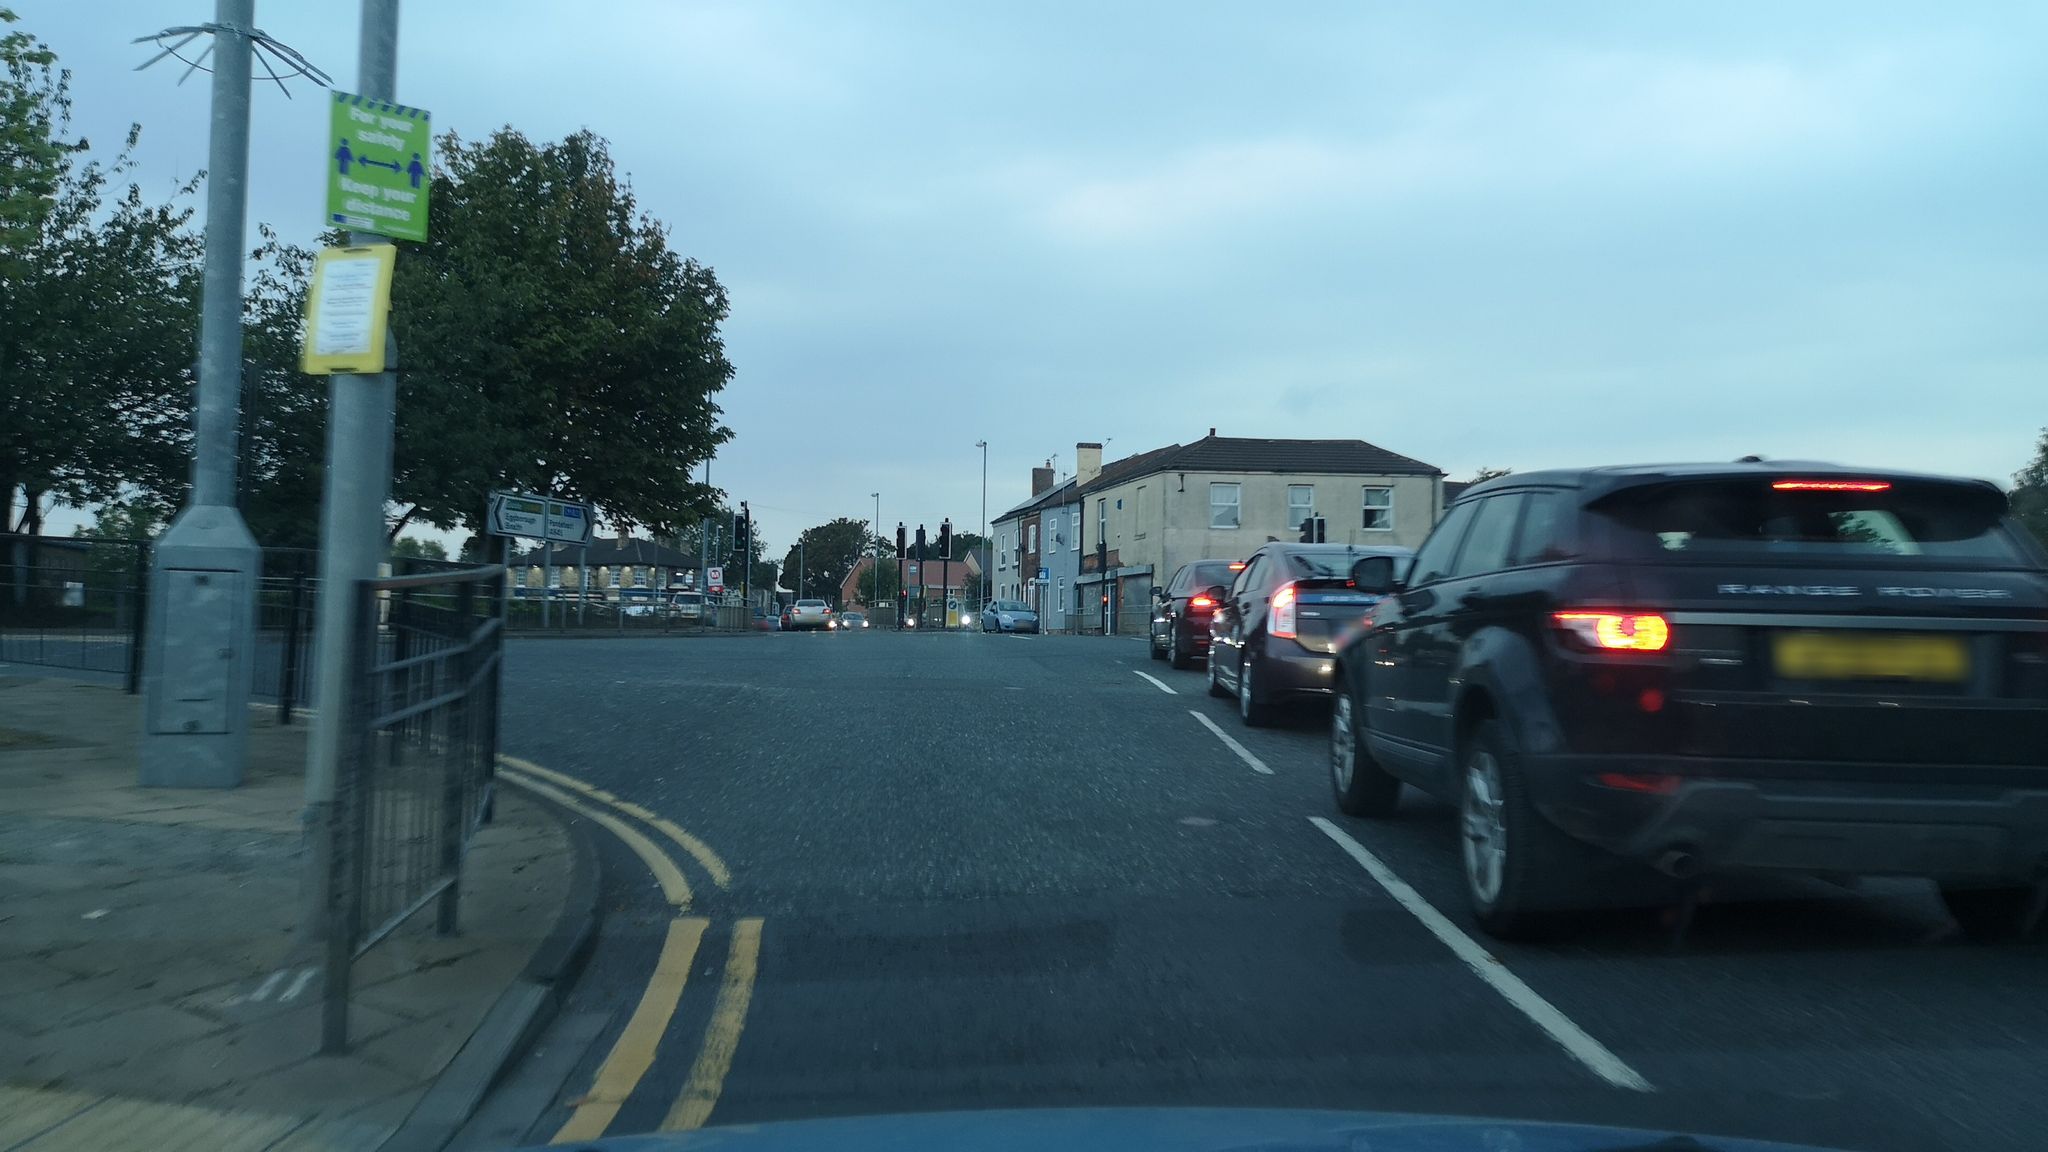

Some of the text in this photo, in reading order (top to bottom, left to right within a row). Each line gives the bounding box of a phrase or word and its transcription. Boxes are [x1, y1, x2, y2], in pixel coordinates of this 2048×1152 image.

[350, 106, 414, 133] For your
[357, 129, 404, 153] safety
[340, 178, 416, 204] Keep your
[345, 197, 411, 222] distance
[1716, 583, 2013, 600] RANGE ROVER
